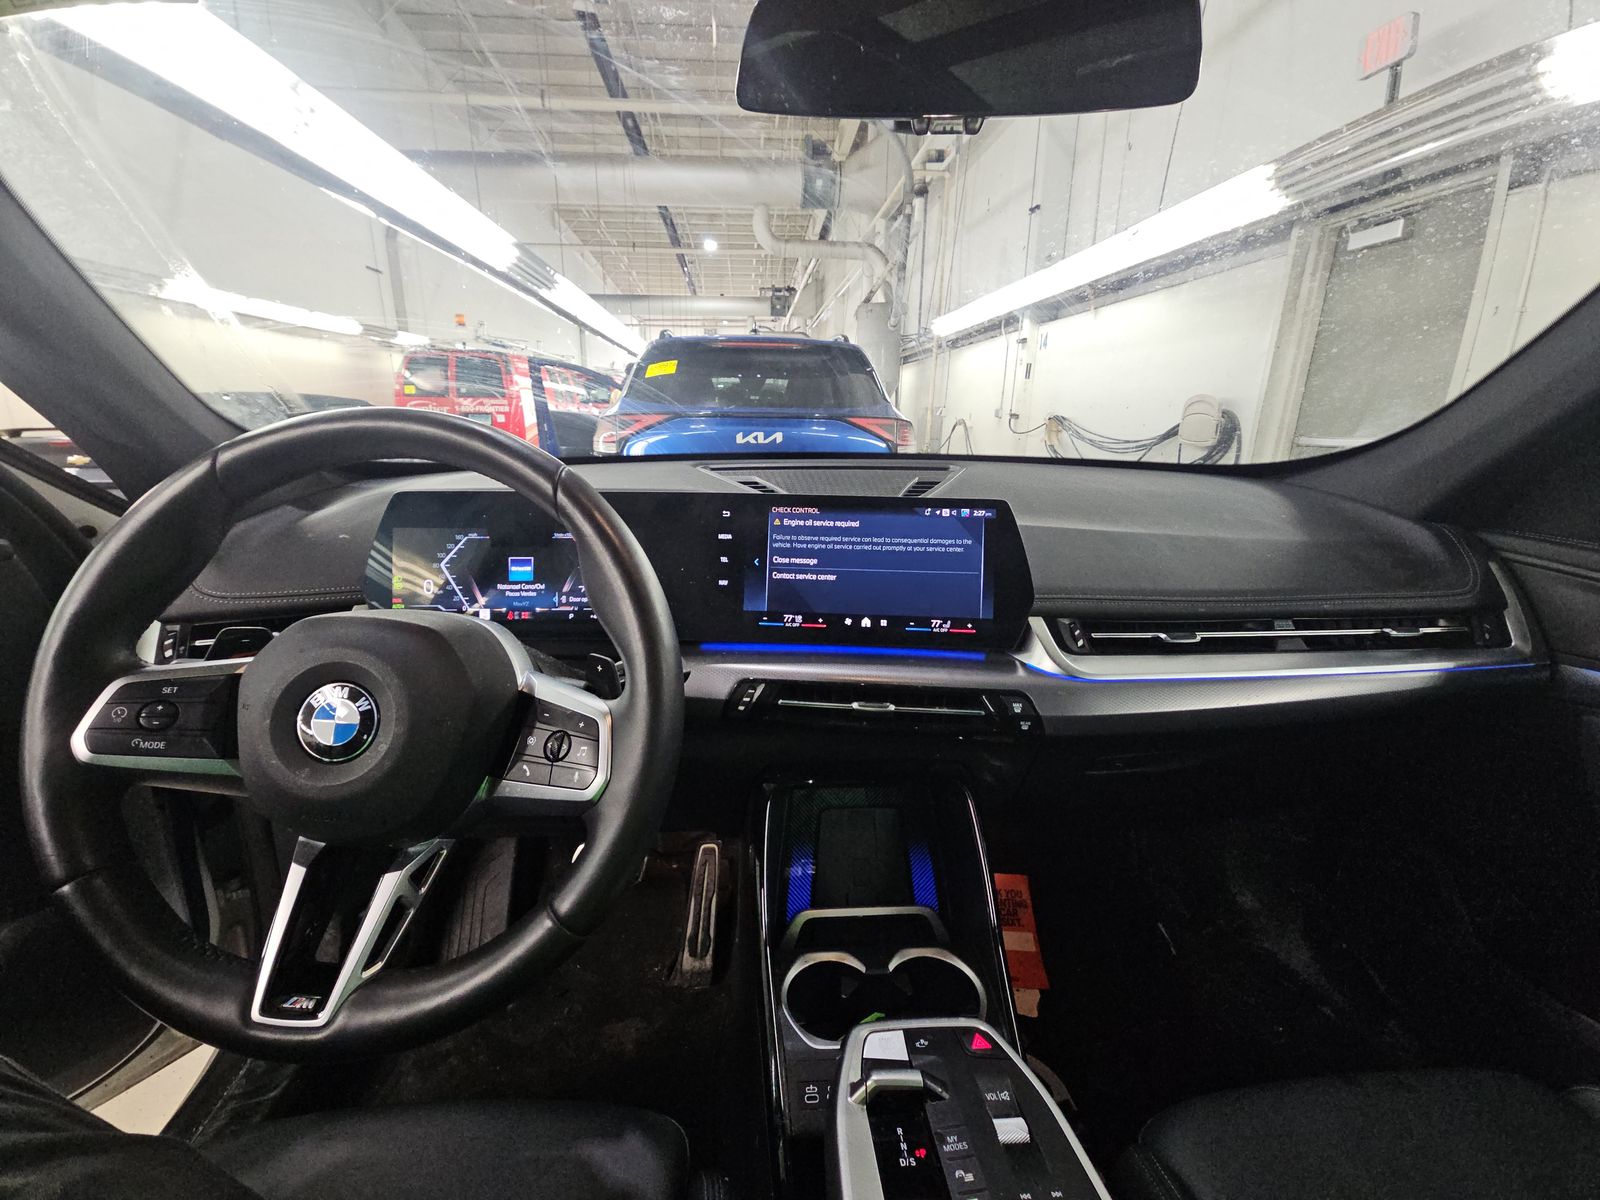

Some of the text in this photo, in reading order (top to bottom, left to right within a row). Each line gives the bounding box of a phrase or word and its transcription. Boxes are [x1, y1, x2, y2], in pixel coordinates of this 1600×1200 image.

[736, 432, 783, 444] KIA
[790, 557, 818, 565] message
[424, 580, 433, 594] 0
[310, 686, 372, 712] BMW
[1004, 889, 1022, 898] YOU
[985, 1093, 998, 1101] VOL
[897, 1128, 903, 1136] R
[943, 1142, 968, 1152] MODES
